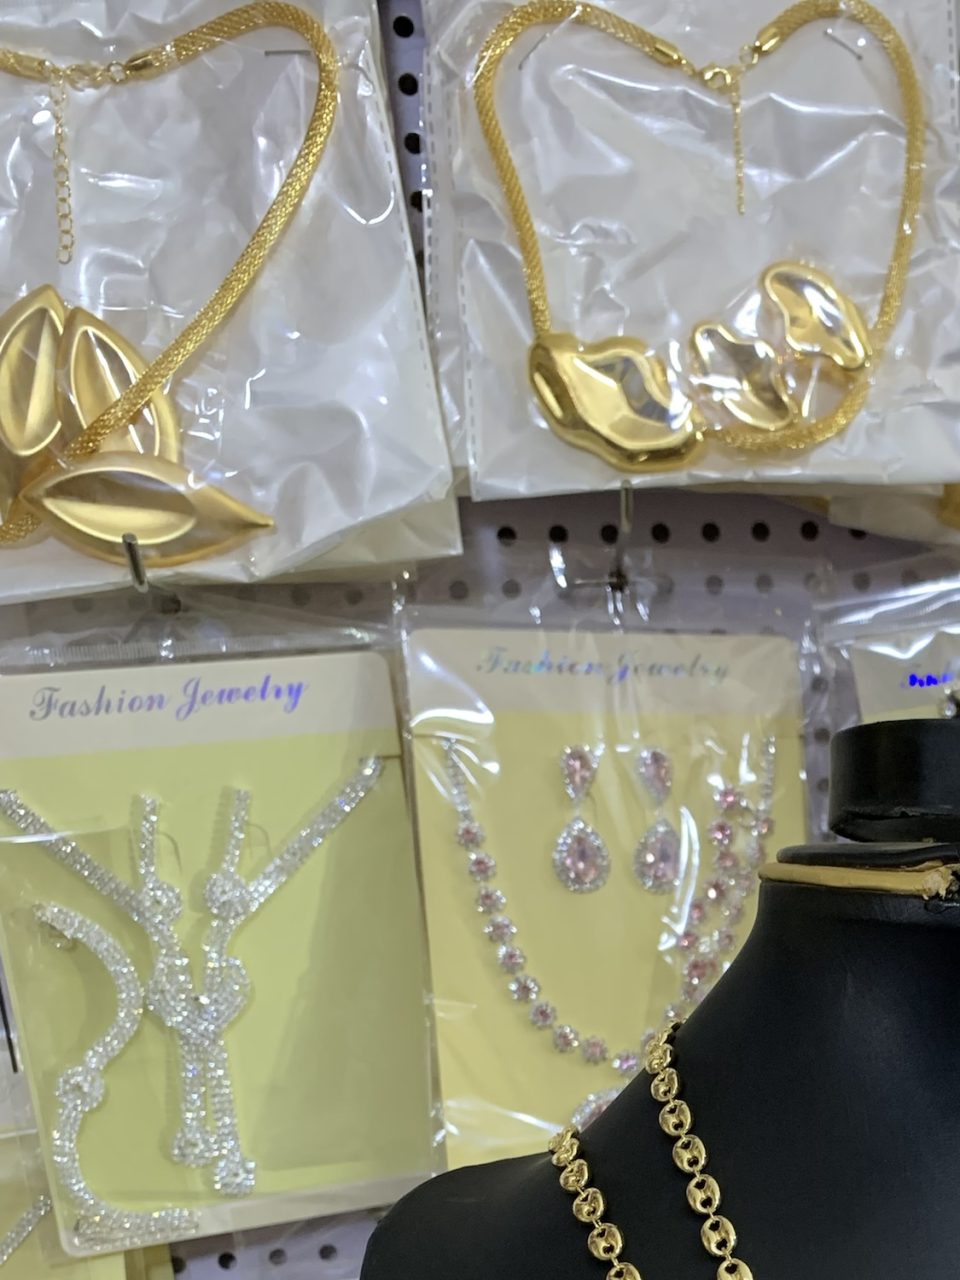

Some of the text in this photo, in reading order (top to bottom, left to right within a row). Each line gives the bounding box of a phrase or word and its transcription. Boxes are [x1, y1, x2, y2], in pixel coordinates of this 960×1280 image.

[477, 646, 602, 674] Fashion
[29, 672, 309, 722] Fashion Jewelry
